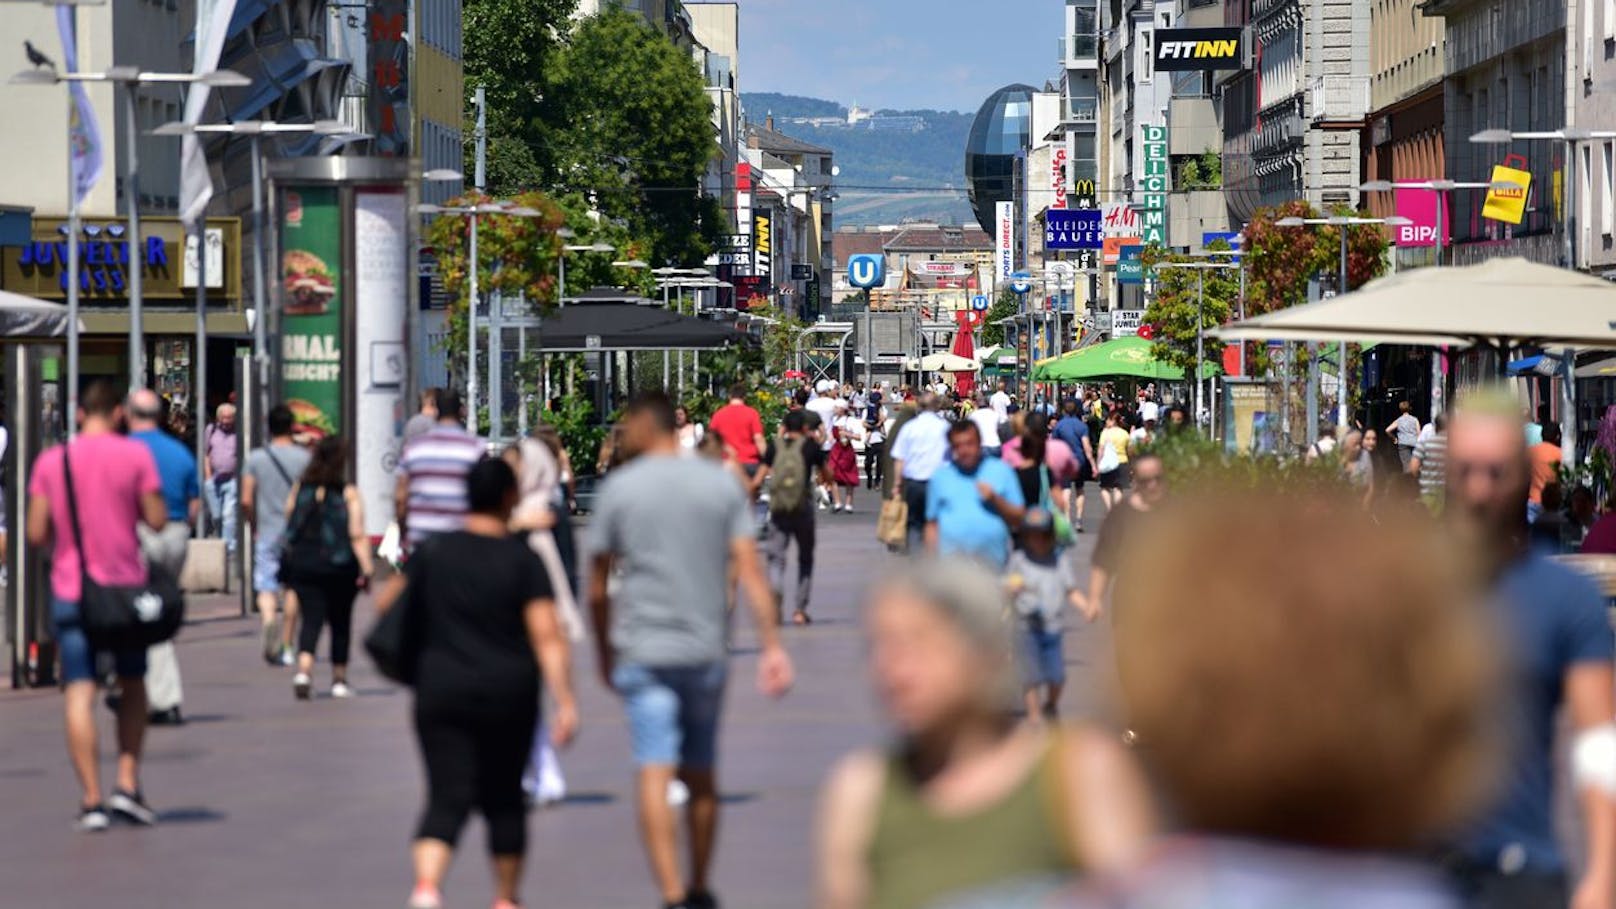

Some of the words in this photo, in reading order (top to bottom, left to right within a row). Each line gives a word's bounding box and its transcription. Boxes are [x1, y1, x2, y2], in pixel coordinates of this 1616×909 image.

[1158, 40, 1238, 59] FITINN
[1148, 128, 1162, 244] DEICHMA
[1047, 232, 1105, 242] BAUER
[1401, 226, 1443, 241] BIPA
[22, 237, 168, 266] JUWELIR
[854, 262, 874, 286] U
[975, 298, 985, 309] U
[1114, 320, 1143, 328] JUWELI
